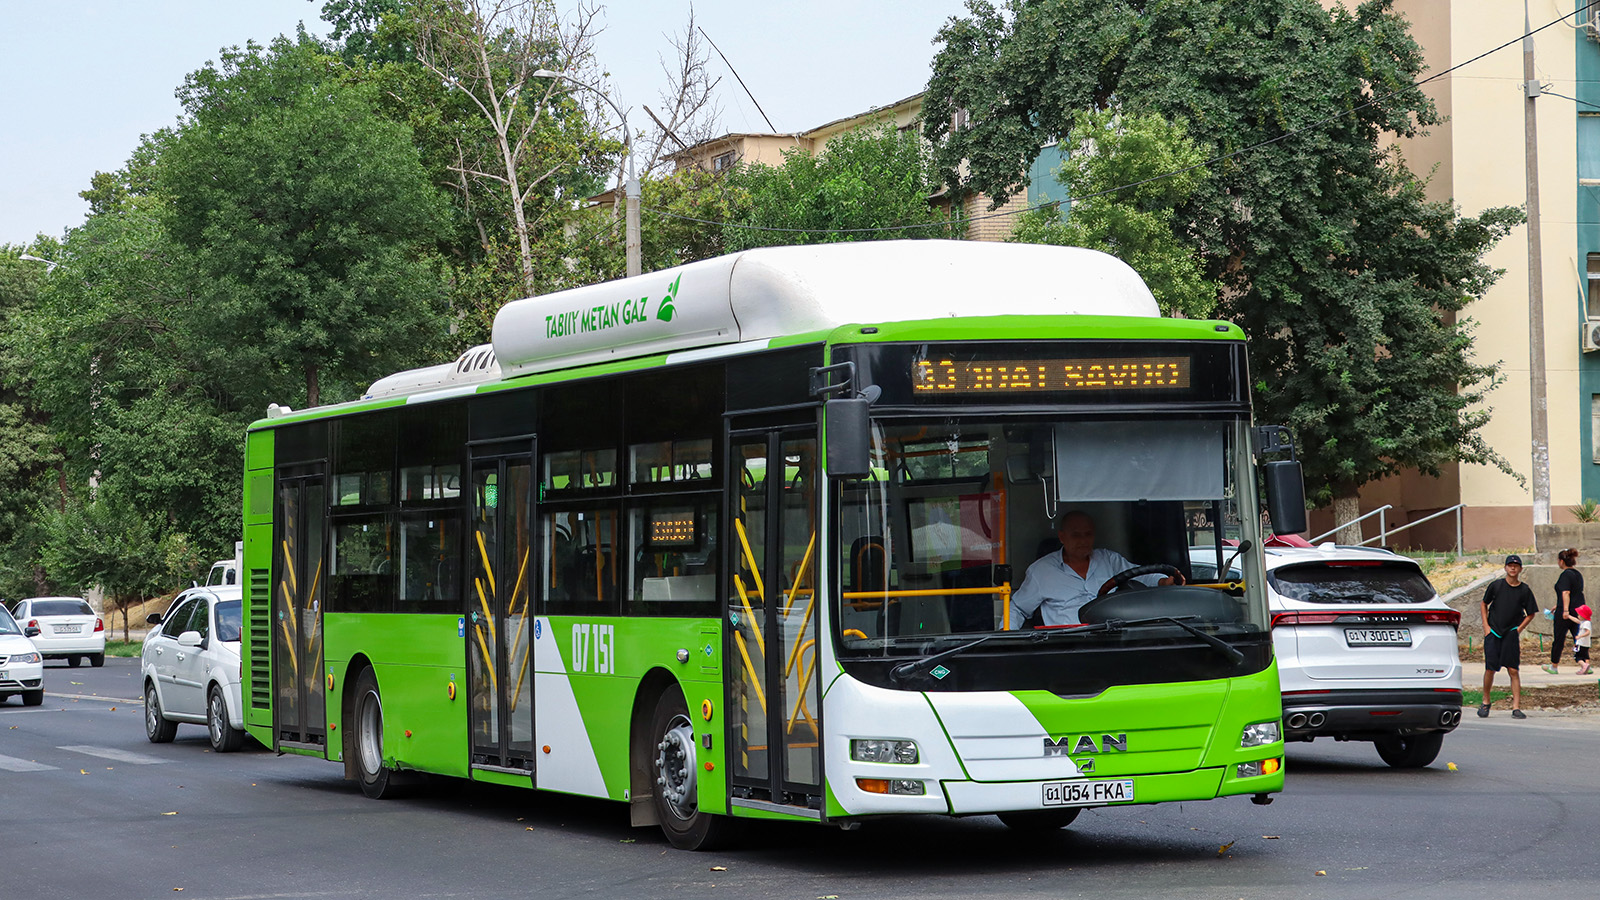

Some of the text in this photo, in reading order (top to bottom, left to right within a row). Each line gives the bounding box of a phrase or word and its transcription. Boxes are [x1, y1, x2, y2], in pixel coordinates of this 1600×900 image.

[545, 296, 648, 338] TABIIY METAN GAZ
[1349, 632, 1359, 640] 01
[572, 623, 615, 675] 07 151
[1043, 733, 1127, 757] MAN
[1046, 788, 1060, 801] 01
[1063, 784, 1090, 802] 054
[1094, 782, 1125, 800] FKA
